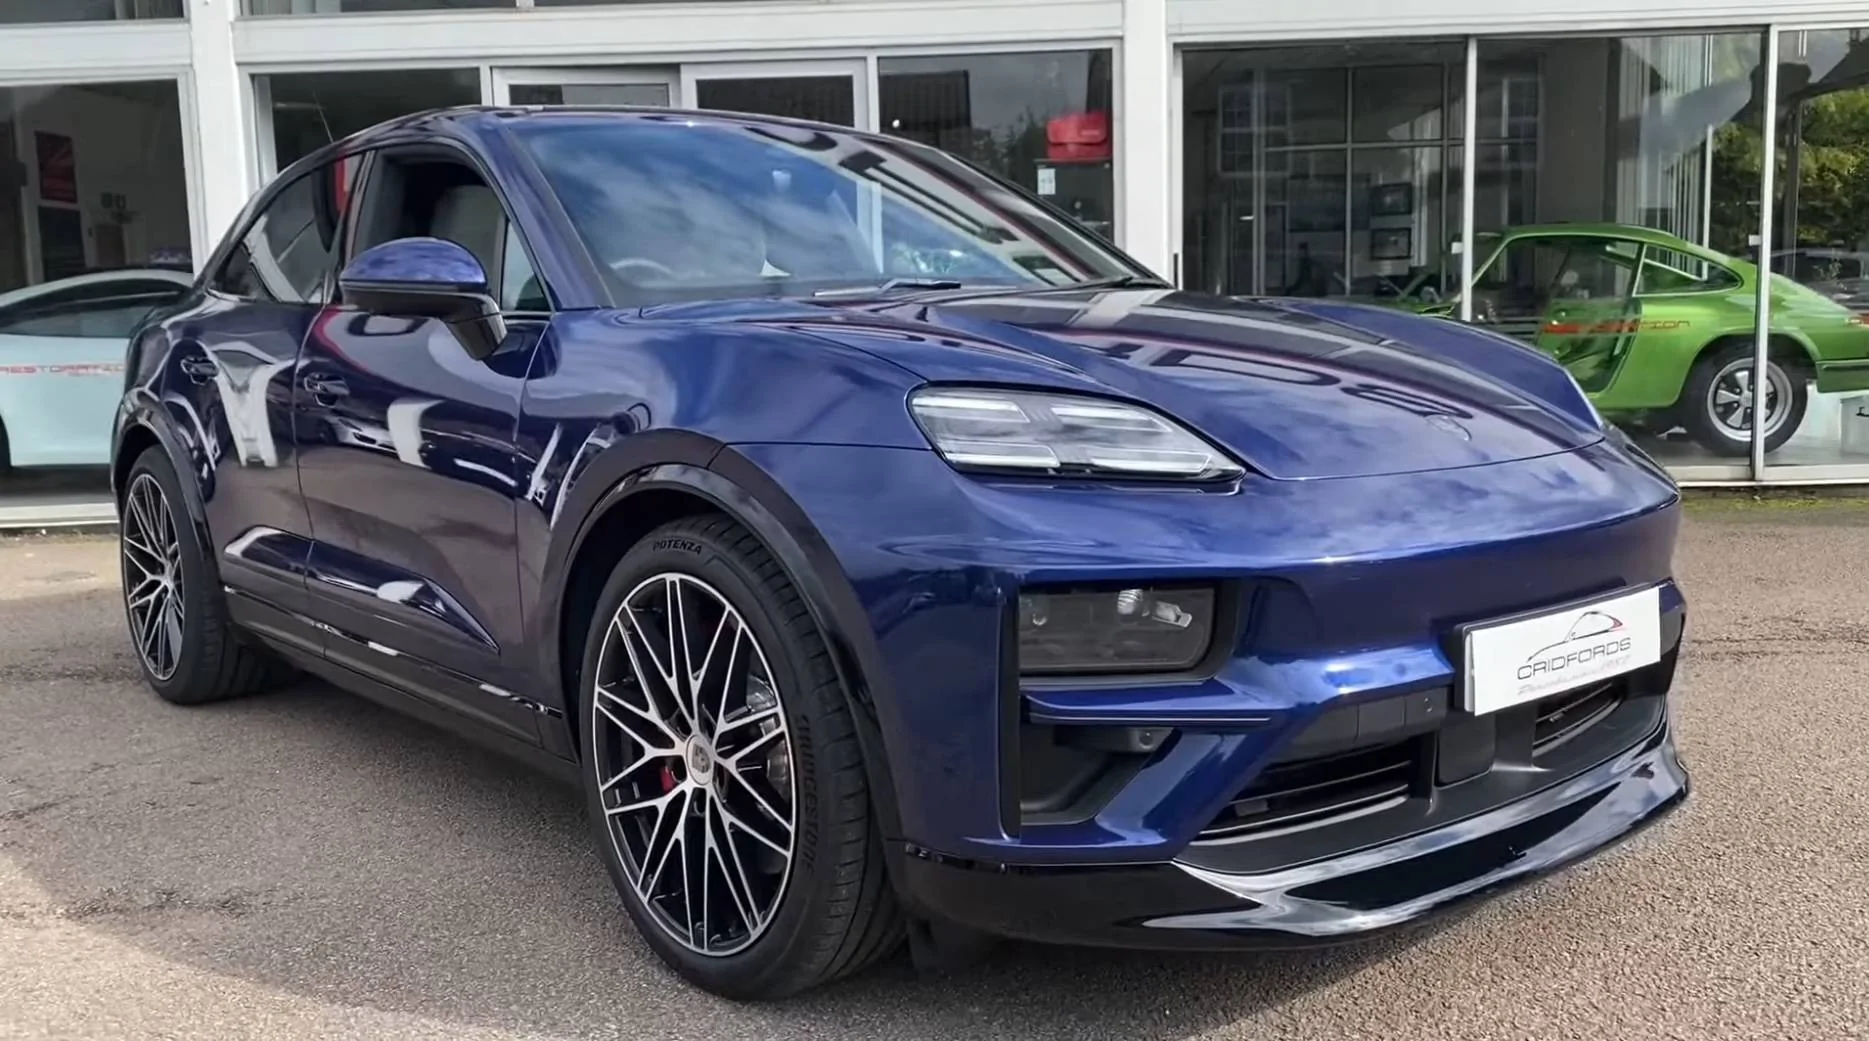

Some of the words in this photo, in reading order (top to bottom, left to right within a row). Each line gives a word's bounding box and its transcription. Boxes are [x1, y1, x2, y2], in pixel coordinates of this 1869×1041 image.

[652, 539, 702, 555] POTENZA
[1517, 637, 1631, 680] CRIDFORDS
[795, 714, 818, 877] BRIDGESTONE
